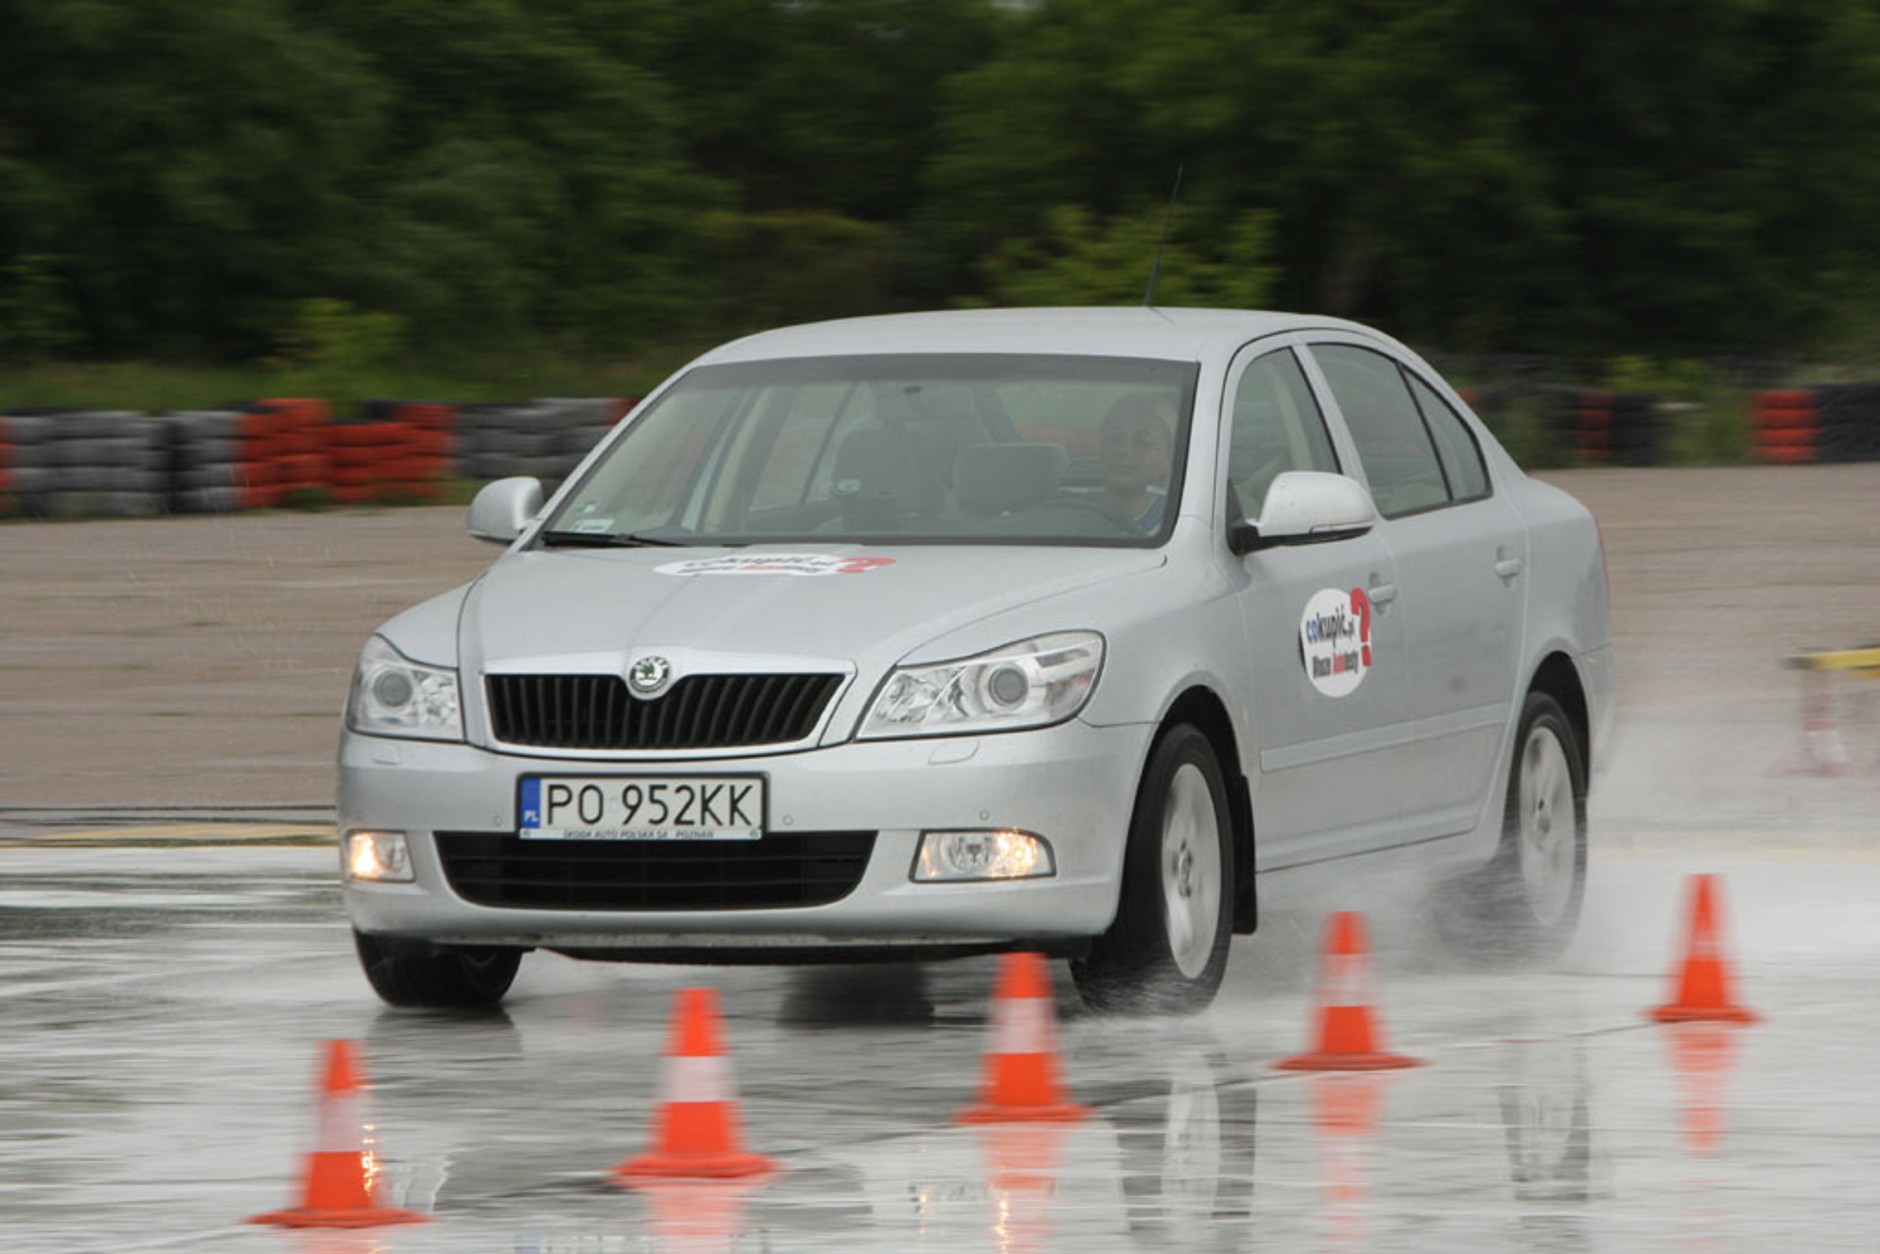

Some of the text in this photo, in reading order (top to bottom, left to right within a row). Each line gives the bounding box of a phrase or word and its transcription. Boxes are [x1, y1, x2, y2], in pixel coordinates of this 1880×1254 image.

[523, 809, 539, 823] PL
[547, 784, 753, 826] PO 952KK
